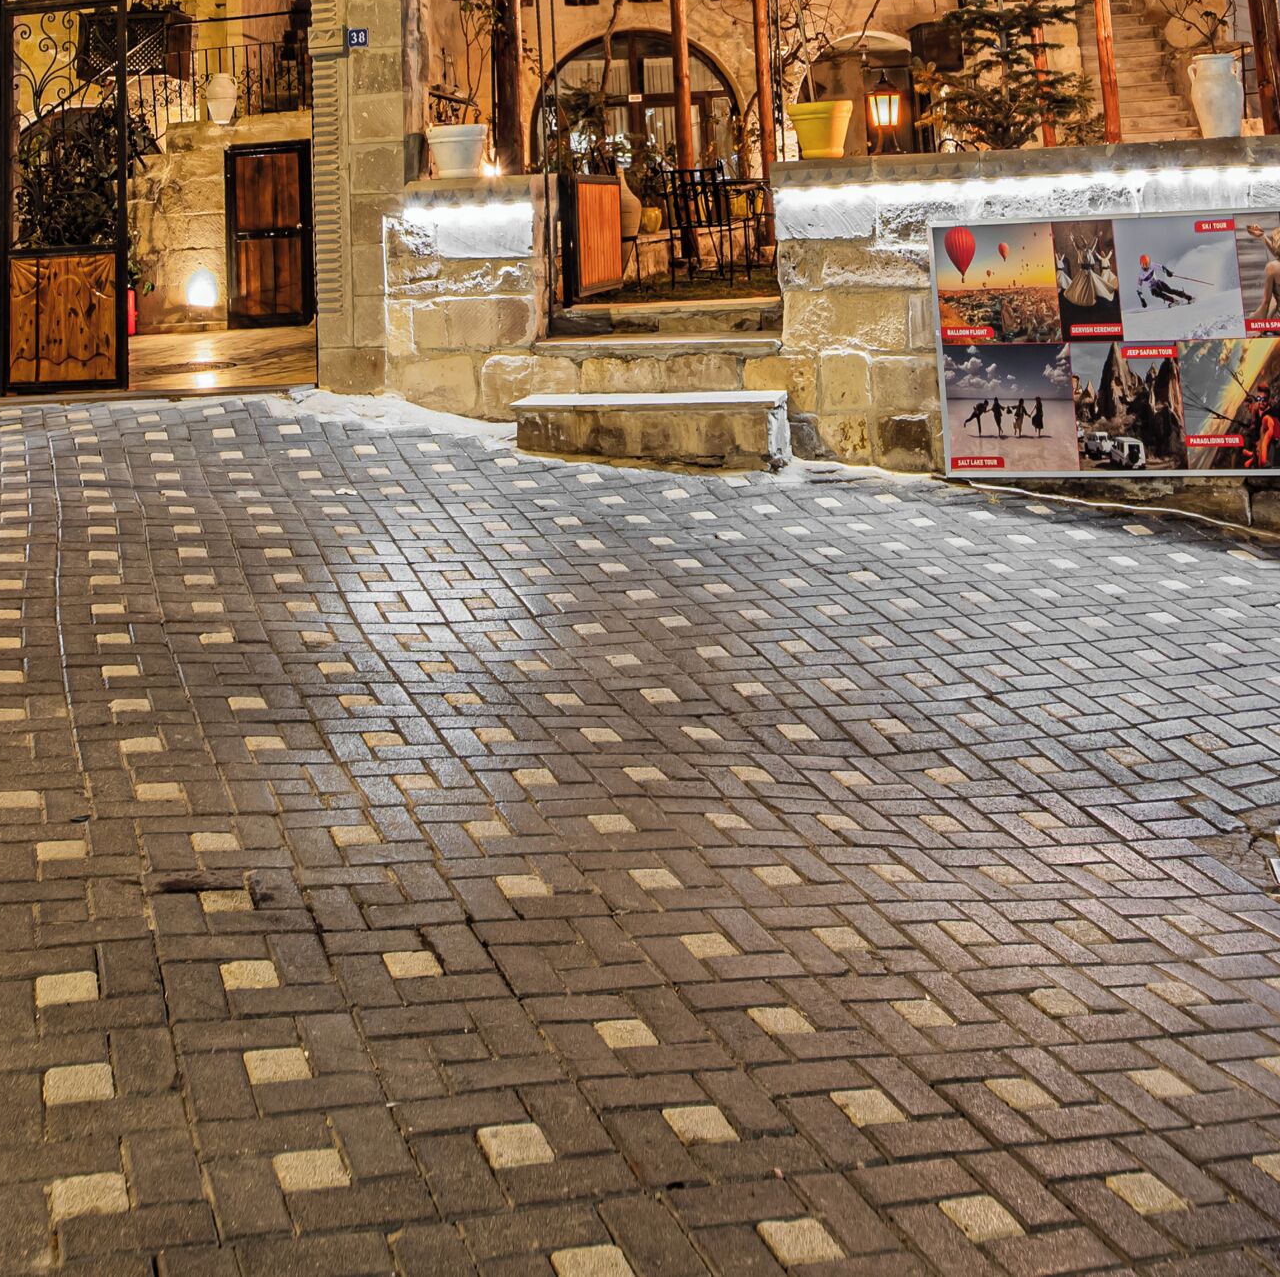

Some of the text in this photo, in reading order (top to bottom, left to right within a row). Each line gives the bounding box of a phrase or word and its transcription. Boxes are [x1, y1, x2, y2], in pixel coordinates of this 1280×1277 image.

[350, 31, 366, 44] 38
[1213, 222, 1227, 230] TOUR
[1071, 325, 1121, 334] DERVISH CEREMONY
